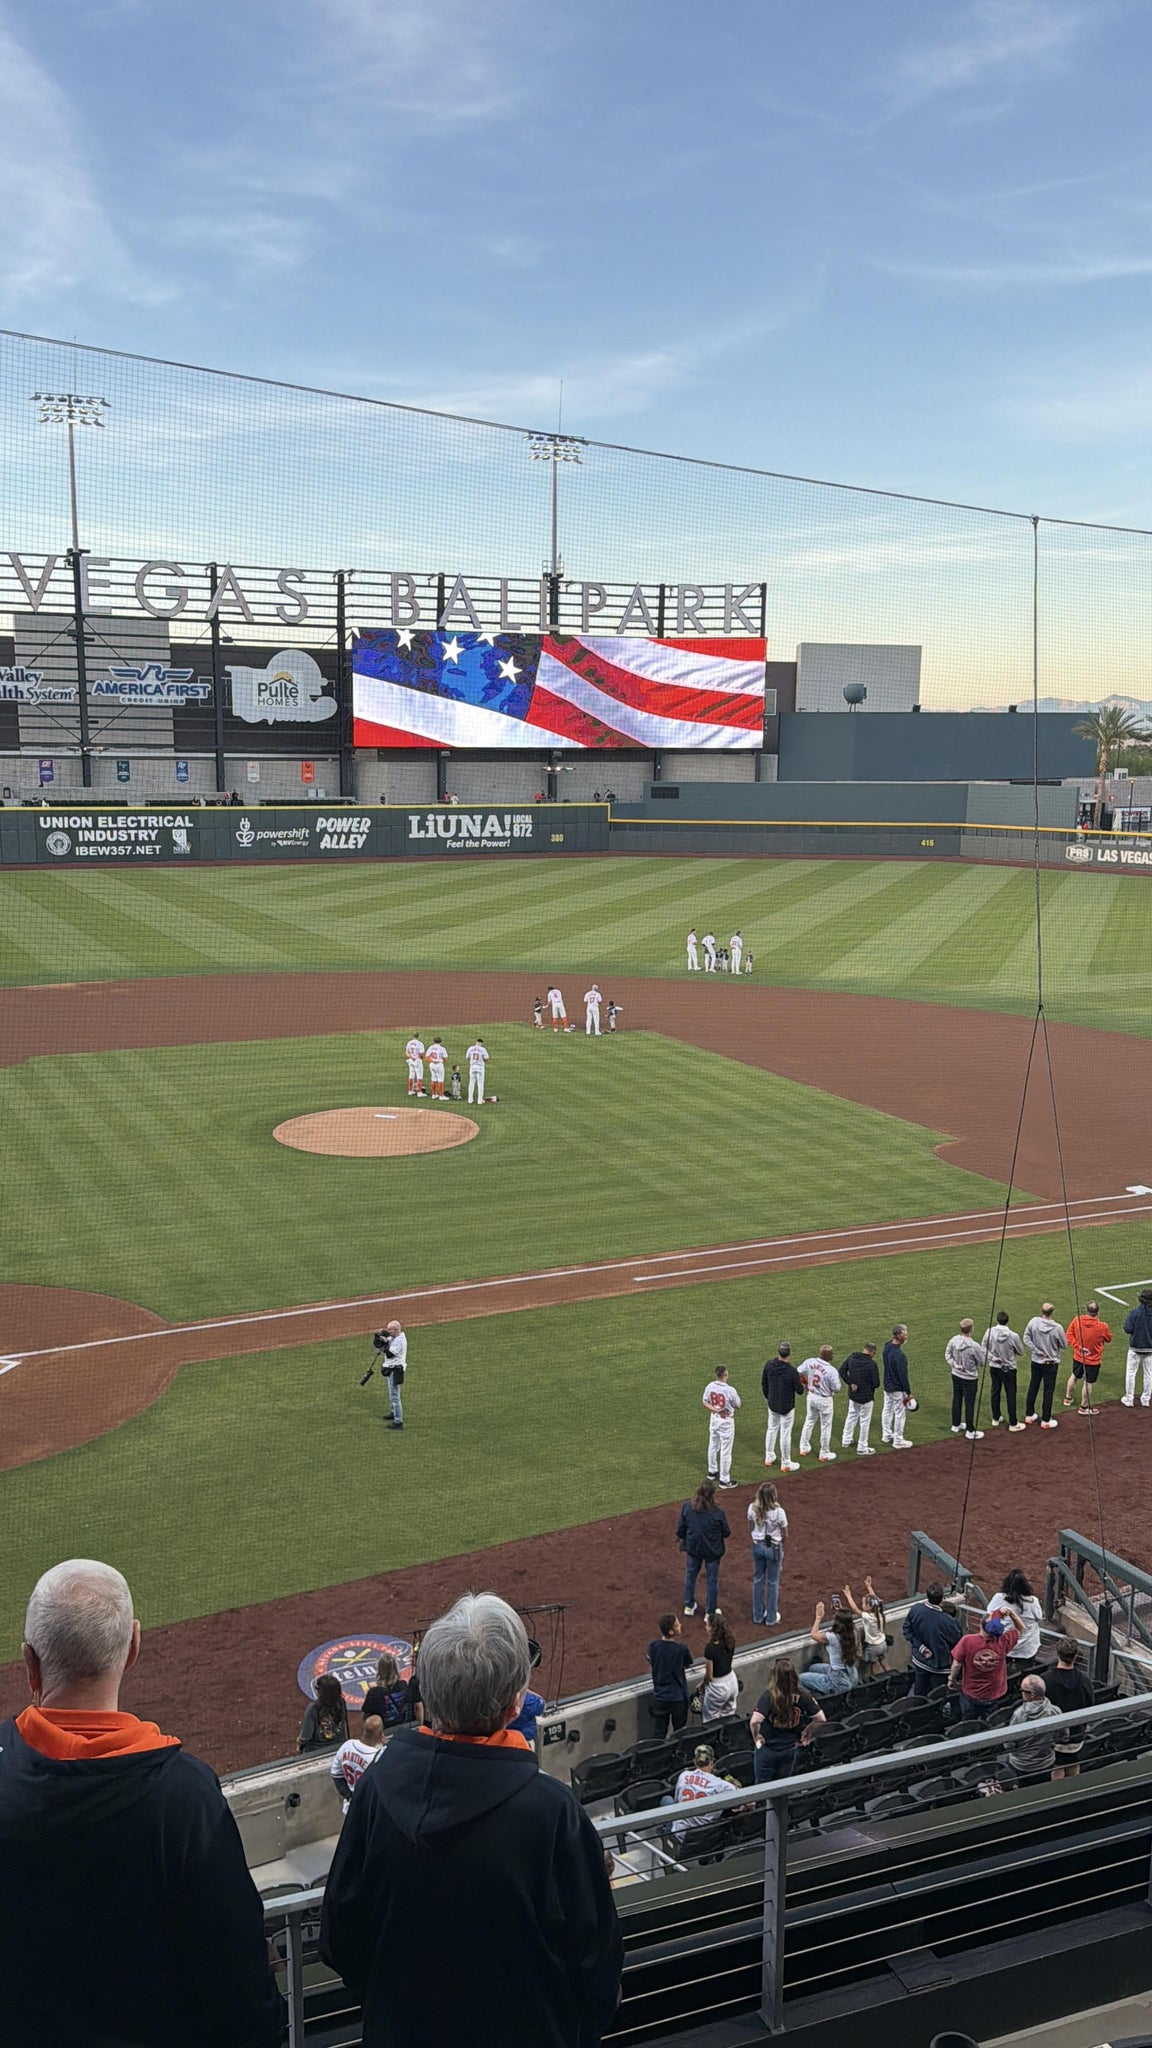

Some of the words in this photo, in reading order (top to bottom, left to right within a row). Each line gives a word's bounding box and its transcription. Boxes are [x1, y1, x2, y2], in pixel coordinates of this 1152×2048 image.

[8, 552, 308, 624] VEGAS
[391, 572, 760, 634] BALLPARK
[93, 682, 164, 695] AMERICA
[166, 684, 209, 696] FIRST
[257, 682, 298, 698] Pulte
[257, 697, 298, 707] HOMES
[39, 816, 93, 829] UNION
[98, 815, 194, 828] ELECTRICAL
[315, 817, 372, 833] POWER
[408, 813, 511, 839] LiUNA!
[513, 814, 533, 824] LOCAL
[78, 829, 158, 842] INDUSTRY
[256, 827, 310, 841] powershift
[513, 823, 533, 838] 872
[319, 833, 367, 850] ALLEY
[446, 839, 464, 849] Feel
[465, 838, 480, 848] the
[480, 838, 510, 848] Power!
[920, 839, 935, 847] 415
[75, 844, 162, 856] IBEW357.NET
[1097, 848, 1118, 862] LAS
[342, 1751, 369, 1770] MARTINE
